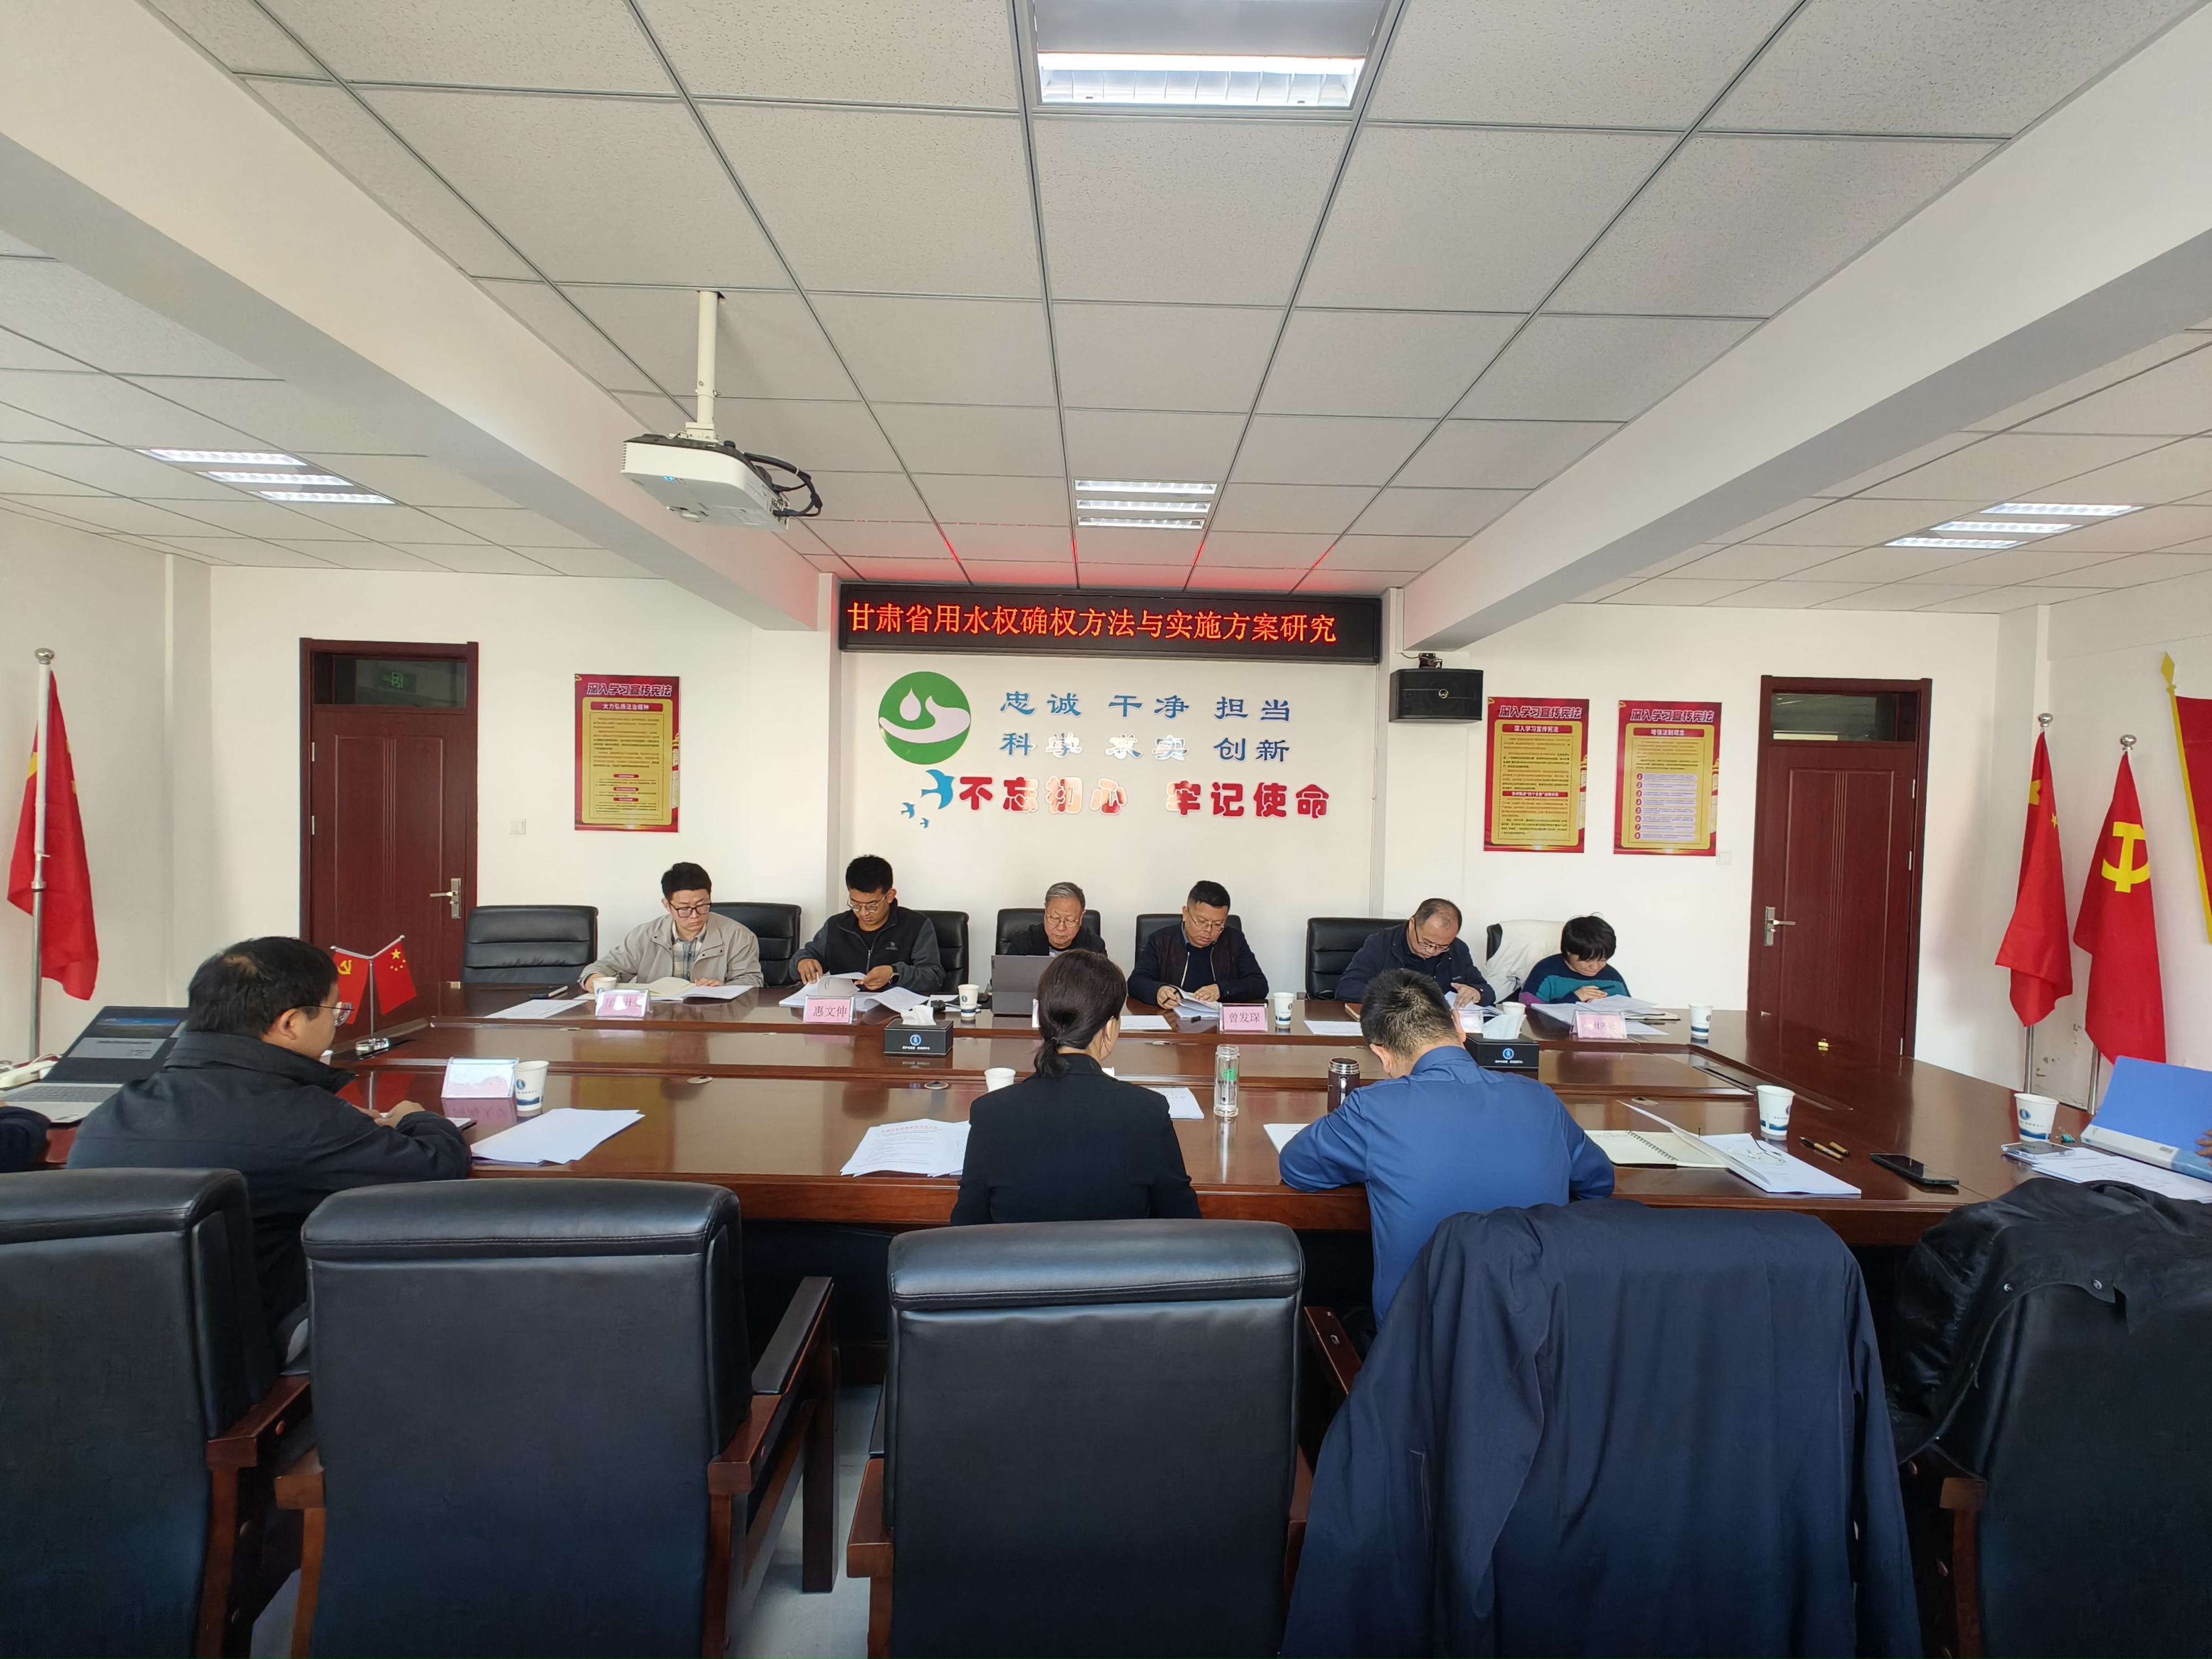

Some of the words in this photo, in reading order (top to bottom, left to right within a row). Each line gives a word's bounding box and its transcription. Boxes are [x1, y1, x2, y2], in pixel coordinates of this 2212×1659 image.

[847, 602, 1337, 643] 甘肃省用水权确权方法与实施方案研究
[587, 683, 672, 696] 深入学习宣传宪法
[1000, 691, 1082, 716] 忠诚
[1109, 695, 1189, 718] 干净
[1214, 697, 1290, 722] 担当
[1499, 705, 1582, 719] 深入学习宣传宪法
[1630, 708, 1714, 722] 深入学习宣传宪法
[1000, 732, 1082, 758] 科学
[1105, 734, 1188, 761] 求实
[1213, 738, 1290, 762] 创新
[959, 776, 1128, 815] 不忘初心
[1166, 780, 1329, 819] 牢记使命
